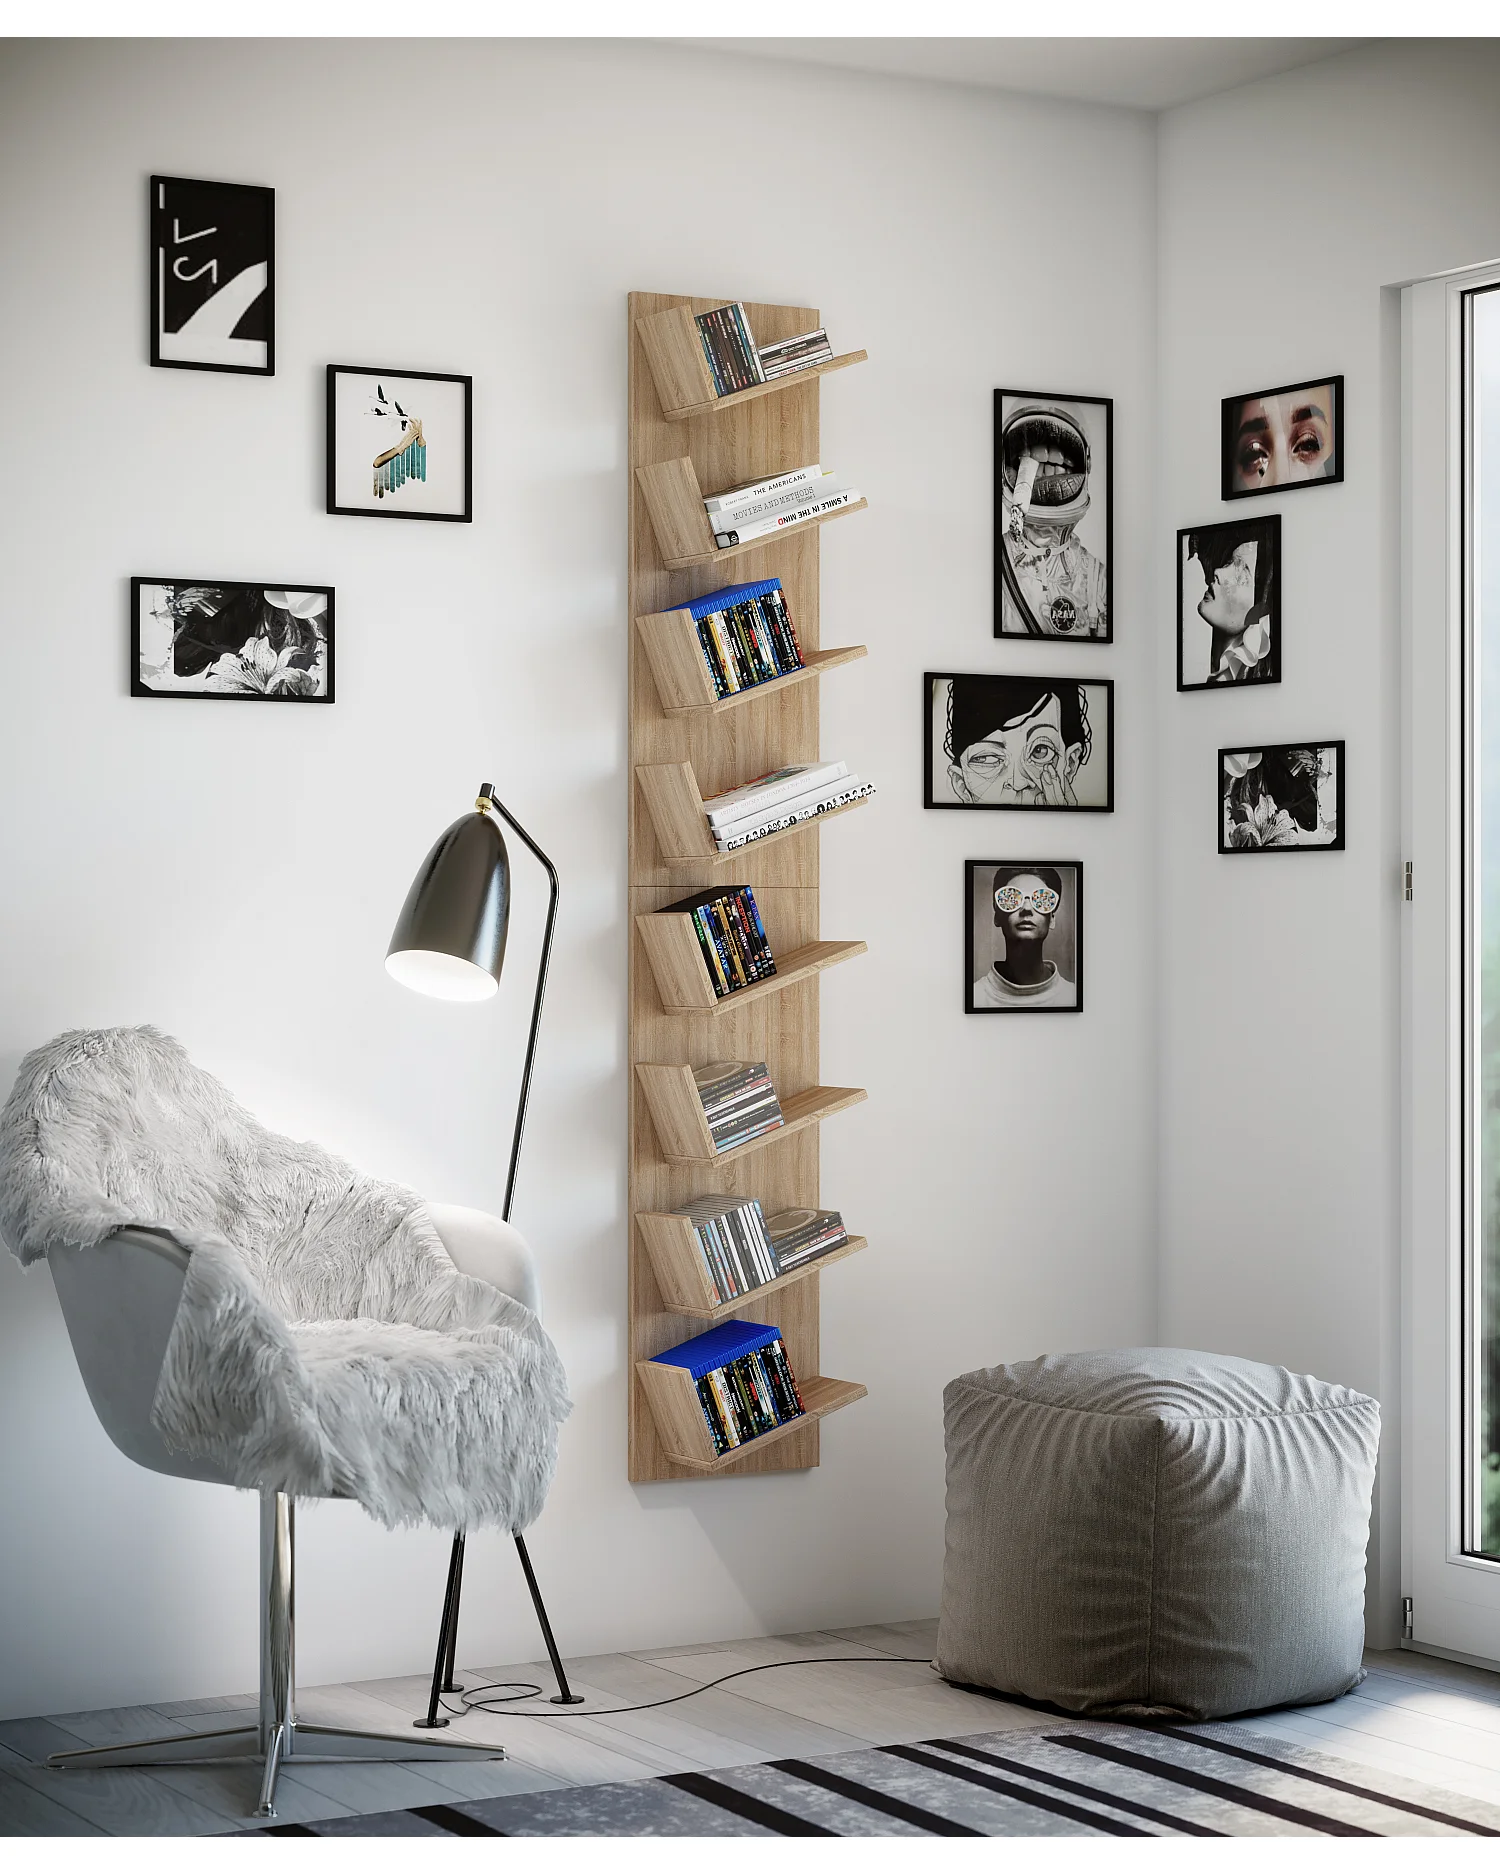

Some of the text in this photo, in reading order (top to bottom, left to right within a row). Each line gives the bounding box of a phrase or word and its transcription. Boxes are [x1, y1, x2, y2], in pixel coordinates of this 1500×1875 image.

[753, 487, 766, 495] THE
[768, 474, 806, 490] AMERICANS
[732, 487, 814, 520] MOVIES AND METHODS
[798, 509, 811, 518] THE
[821, 497, 842, 509] SMILE
[778, 513, 797, 525] MIND
[735, 896, 750, 933] INCEPTION
[694, 914, 704, 941] MATRIX
[715, 939, 728, 969] AVATAR
